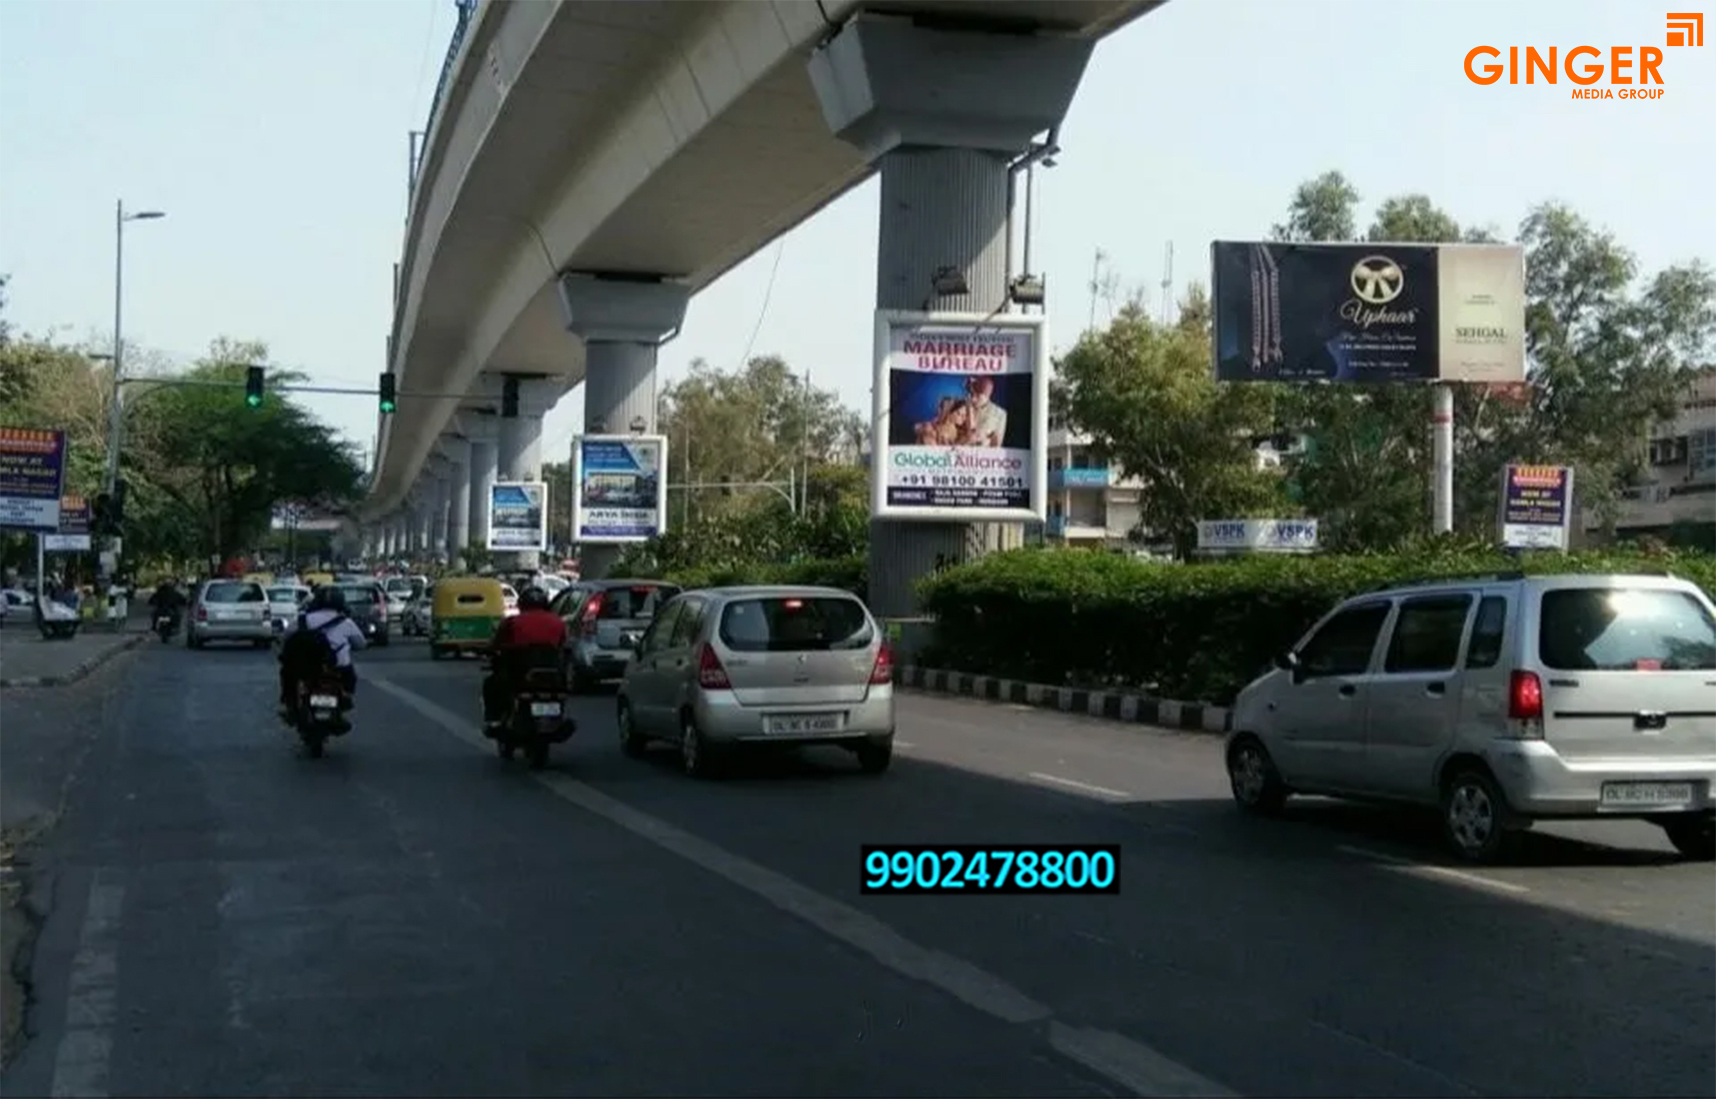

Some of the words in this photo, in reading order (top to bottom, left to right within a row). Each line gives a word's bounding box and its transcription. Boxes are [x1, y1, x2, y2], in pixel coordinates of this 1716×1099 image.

[1455, 327, 1507, 337] SEHGAL
[903, 340, 1016, 357] MARRIAGE
[918, 355, 1002, 371] BUREAU
[894, 452, 951, 468] Global
[954, 455, 1022, 470] Alliance
[902, 474, 926, 485] +91
[931, 475, 976, 486] 98100
[980, 476, 1023, 487] 41501
[1276, 522, 1314, 539] VSPK
